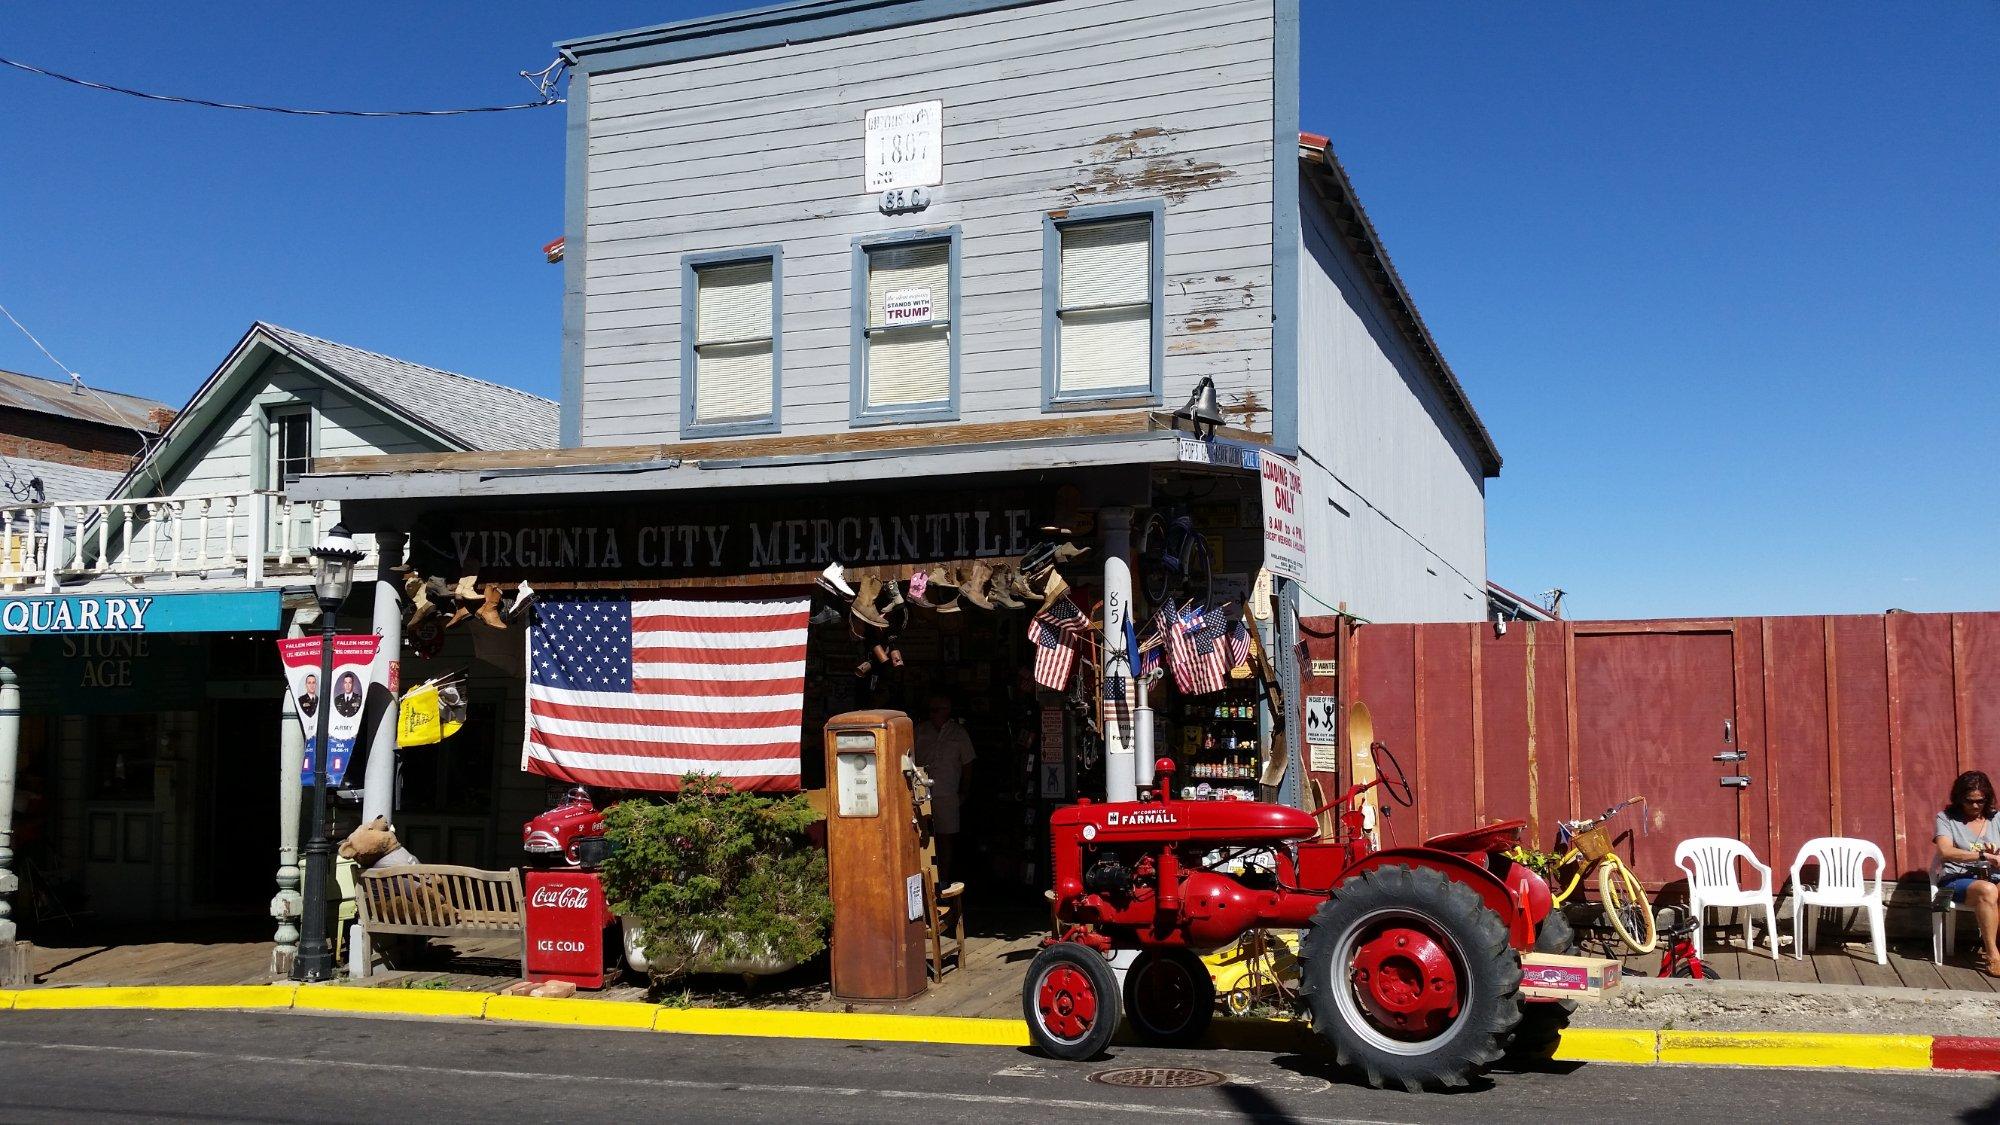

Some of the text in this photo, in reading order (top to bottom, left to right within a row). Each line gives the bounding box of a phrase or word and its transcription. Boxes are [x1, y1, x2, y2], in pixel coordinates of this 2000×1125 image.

[887, 301, 912, 309] STANDS
[887, 306, 930, 319] TRUMP
[1262, 459, 1287, 487] LOADING
[1275, 486, 1294, 514] ONLY
[450, 508, 1031, 568] VIRGINIA CITY MERCANTILE
[2, 597, 153, 632] QUARRY
[63, 633, 151, 658] STONE
[80, 660, 133, 687] AGE
[1318, 662, 1335, 670] WANTE
[1122, 813, 1177, 825] FARMALL
[531, 886, 590, 910] Coca-Cola
[537, 940, 585, 952] ICE COLD
